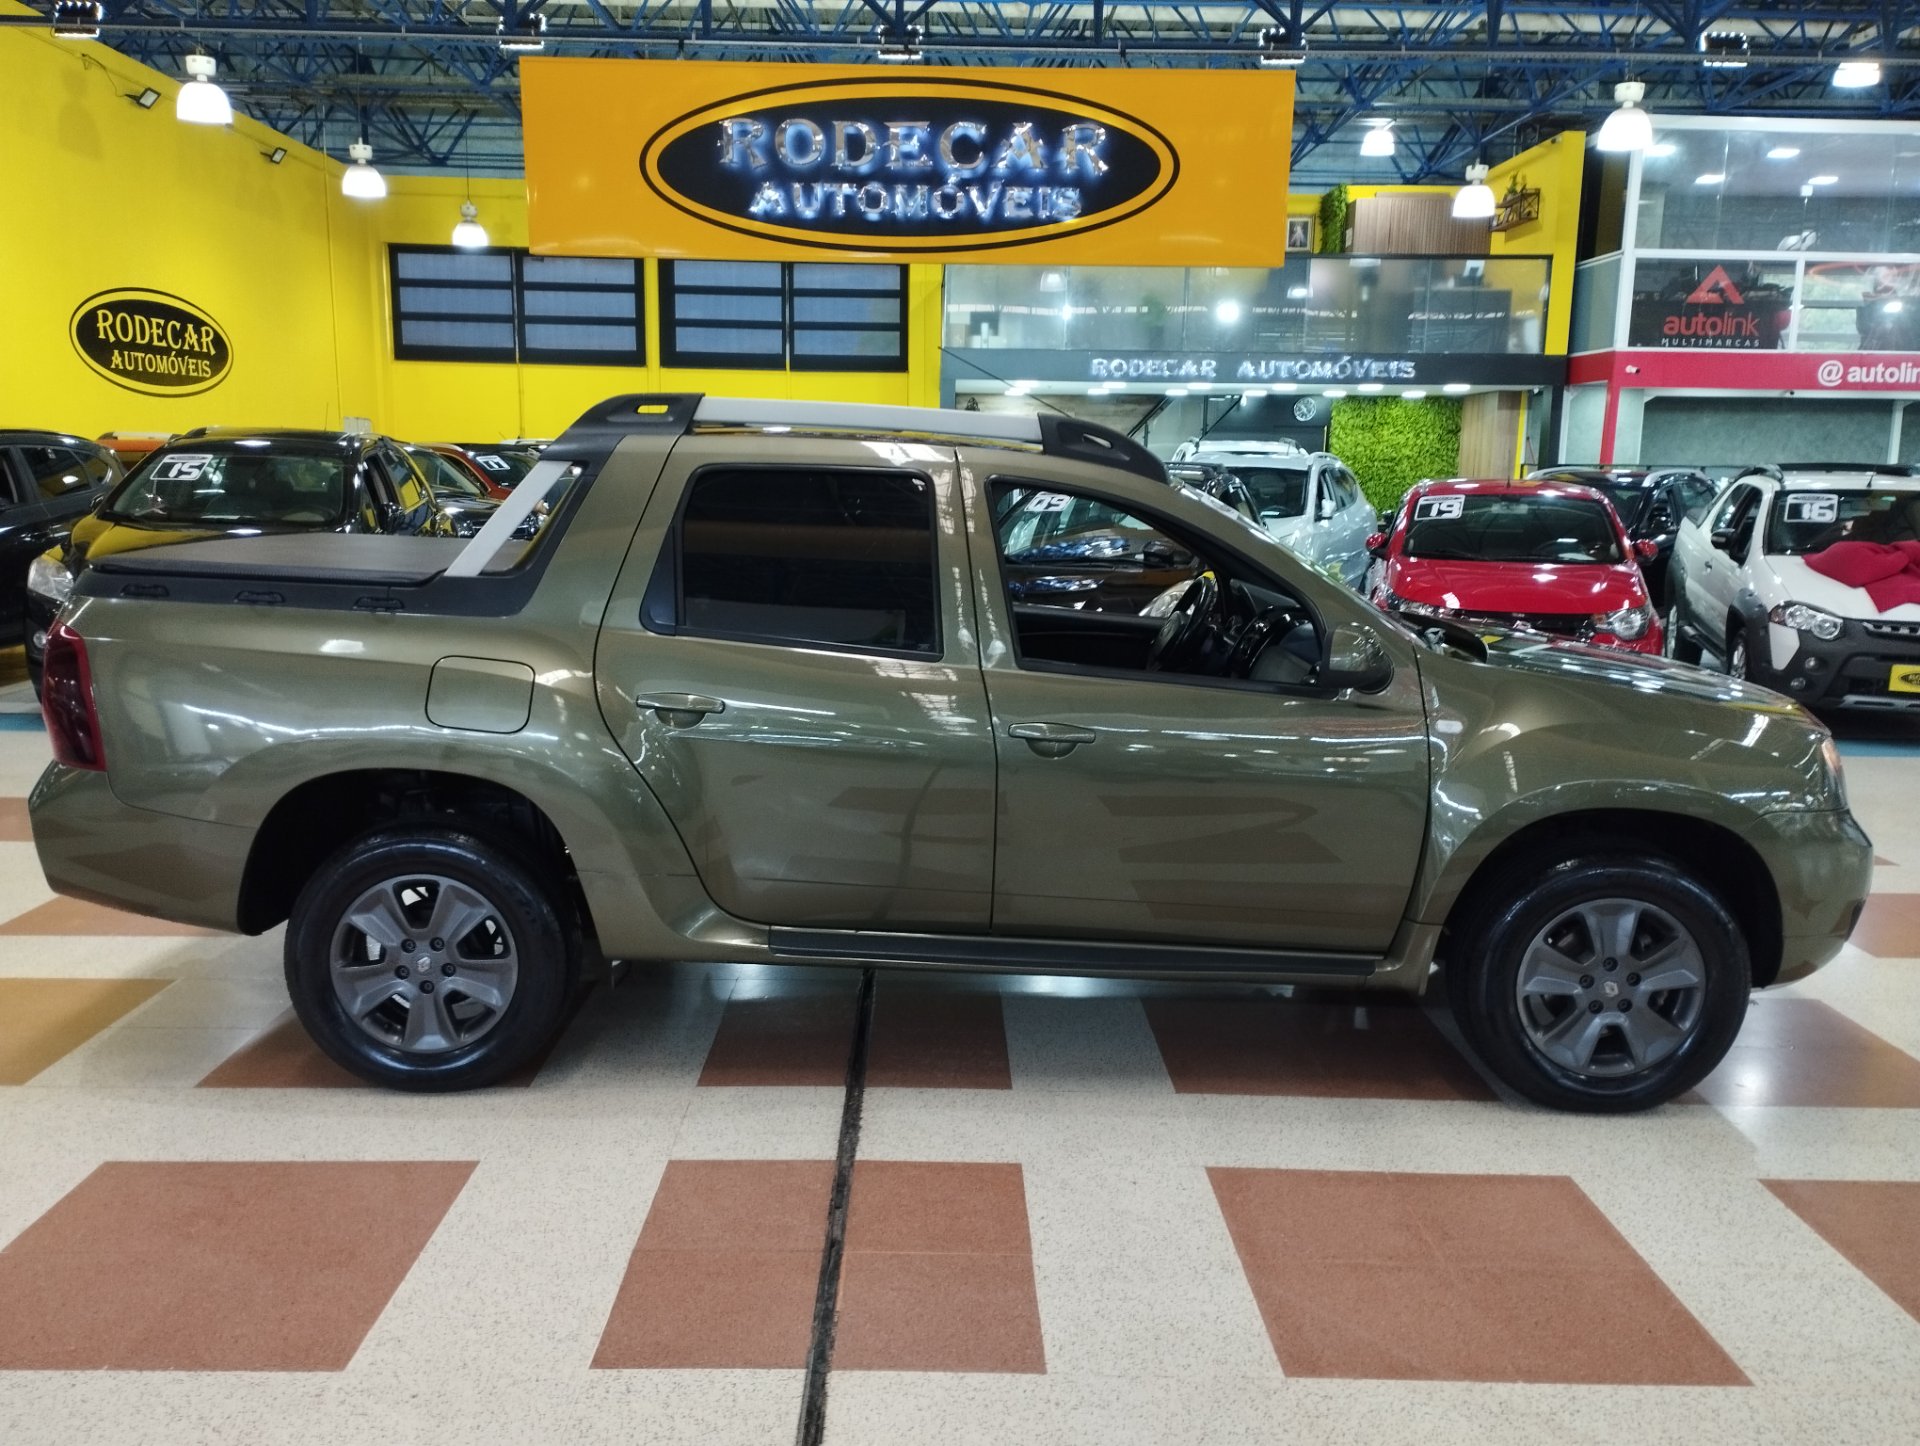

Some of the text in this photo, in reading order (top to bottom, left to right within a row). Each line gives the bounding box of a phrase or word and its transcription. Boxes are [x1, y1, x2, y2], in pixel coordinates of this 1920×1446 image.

[717, 117, 1109, 177] RODECAR
[748, 175, 1082, 220] AUTOMÓVEIS
[97, 309, 216, 356] RODECAR
[1663, 312, 1760, 336] autolink
[1661, 338, 1760, 347] MULTIMARCAS
[110, 350, 211, 377] AUTOMÓVEIS
[1091, 355, 1417, 378] RODECAR AUTOMÓVEIS
[168, 462, 201, 479] 15
[1025, 496, 1069, 511] 09
[1430, 502, 1461, 518] 19
[1801, 502, 1834, 521] 16
